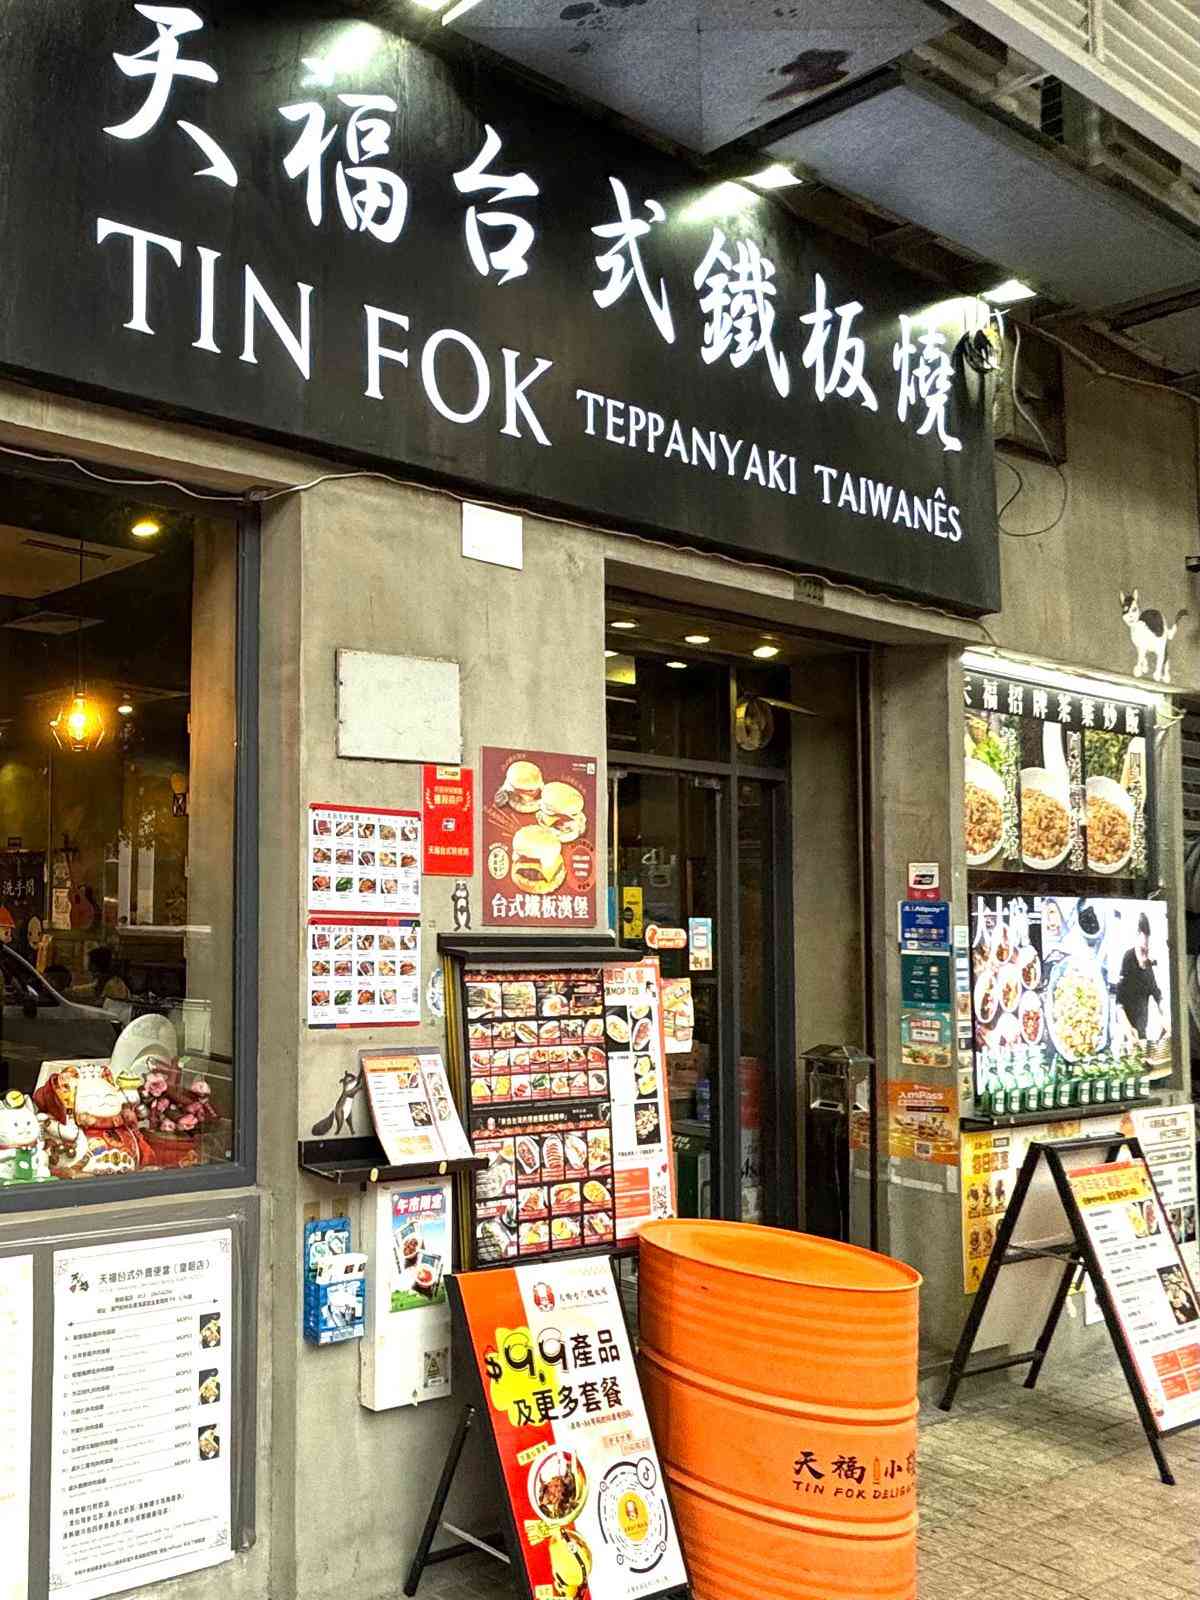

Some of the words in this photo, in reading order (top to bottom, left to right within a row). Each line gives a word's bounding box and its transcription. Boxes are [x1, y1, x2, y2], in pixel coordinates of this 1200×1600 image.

[104, 4, 963, 452] 天福台式鐵板燒
[97, 217, 313, 381] TIN
[364, 304, 553, 446] FOK
[576, 389, 798, 495] TEPPANYAKI
[814, 464, 963, 543] TAIWANÊS
[513, 1376, 623, 1426] 及更多套餐
[792, 1480, 825, 1495] TIN
[834, 1487, 866, 1499] FOK
[793, 1451, 866, 1485] 天福
